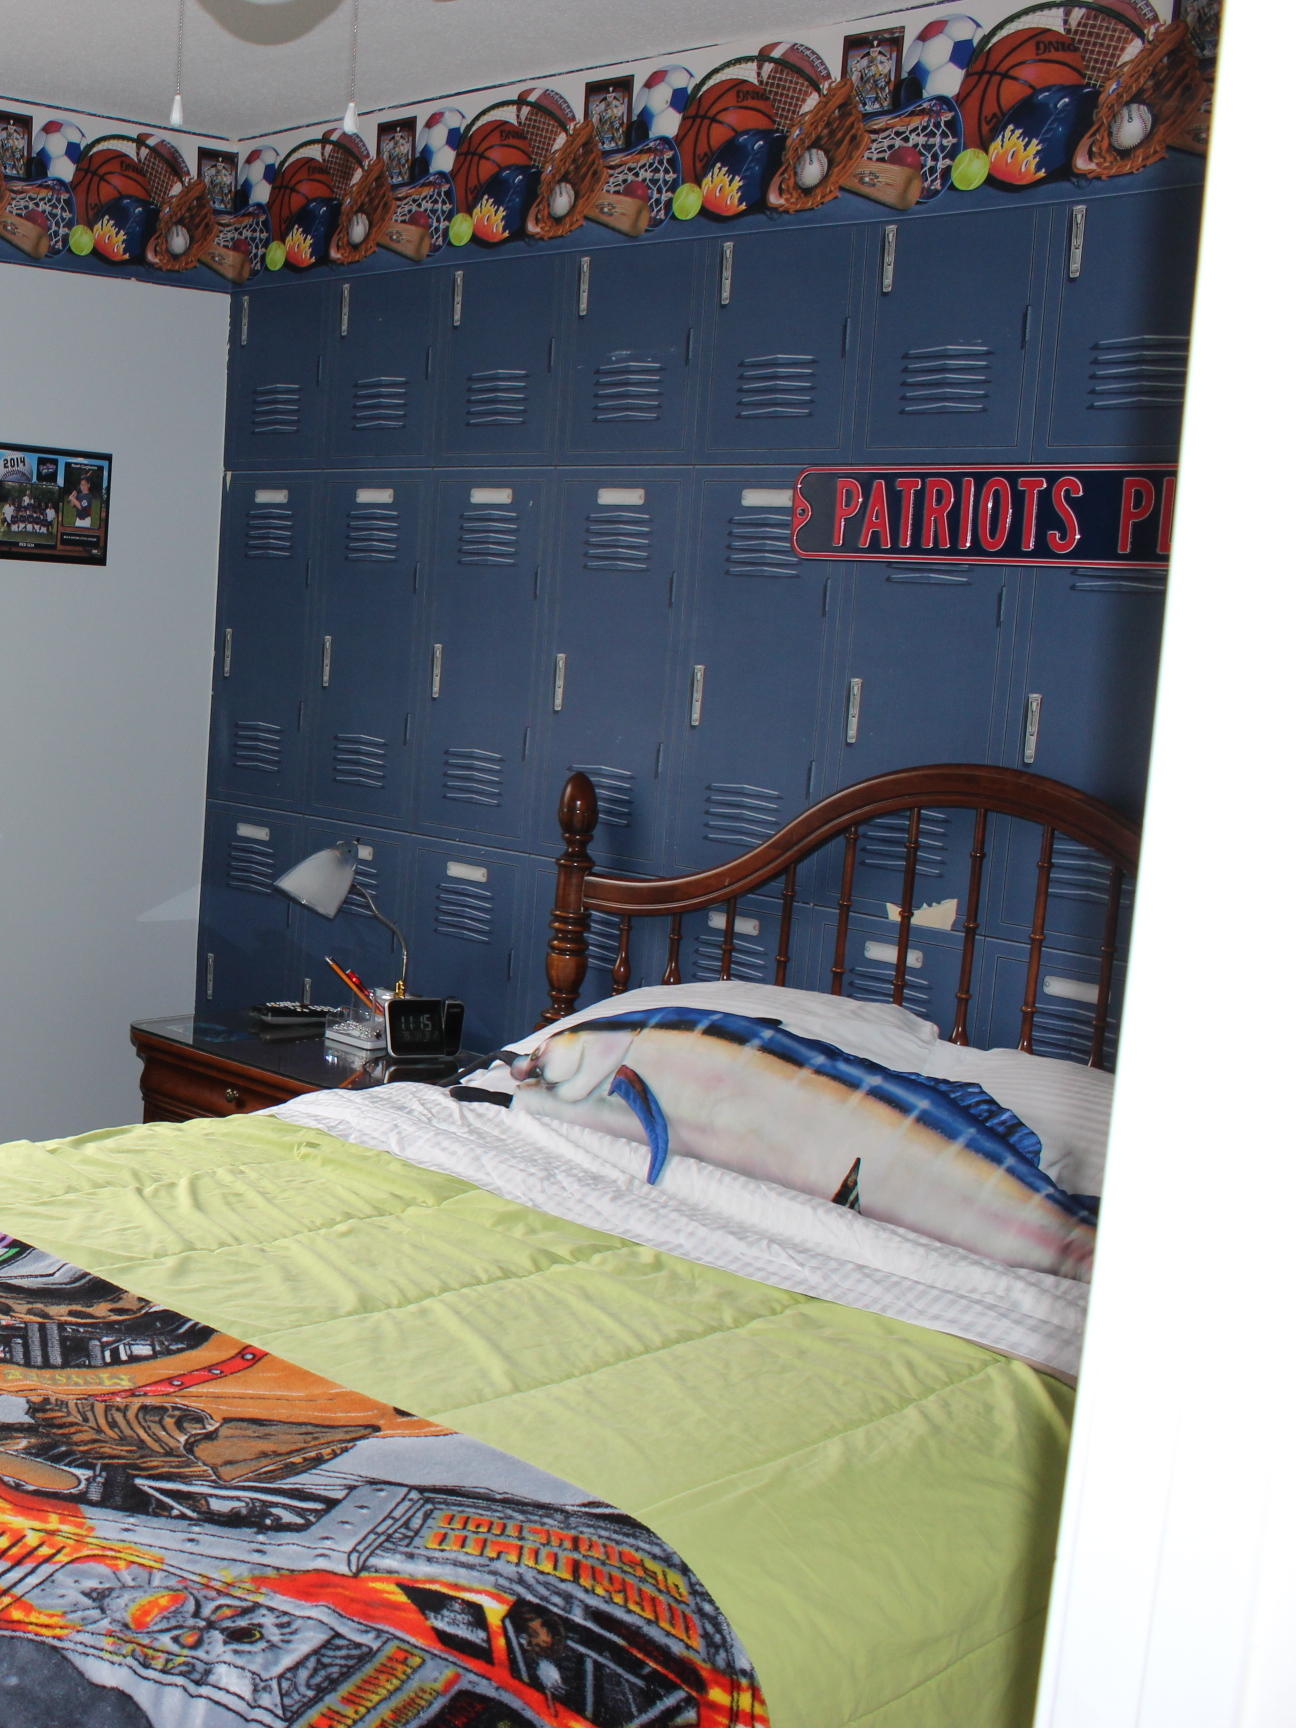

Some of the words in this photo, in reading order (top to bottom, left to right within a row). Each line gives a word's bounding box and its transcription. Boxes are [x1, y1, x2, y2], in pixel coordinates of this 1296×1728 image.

[3, 456, 26, 469] 2014
[832, 477, 1084, 553] PATRIOTS
[425, 1531, 702, 1649] MAXIMUM
[438, 1513, 689, 1602] DESTRUCTION
